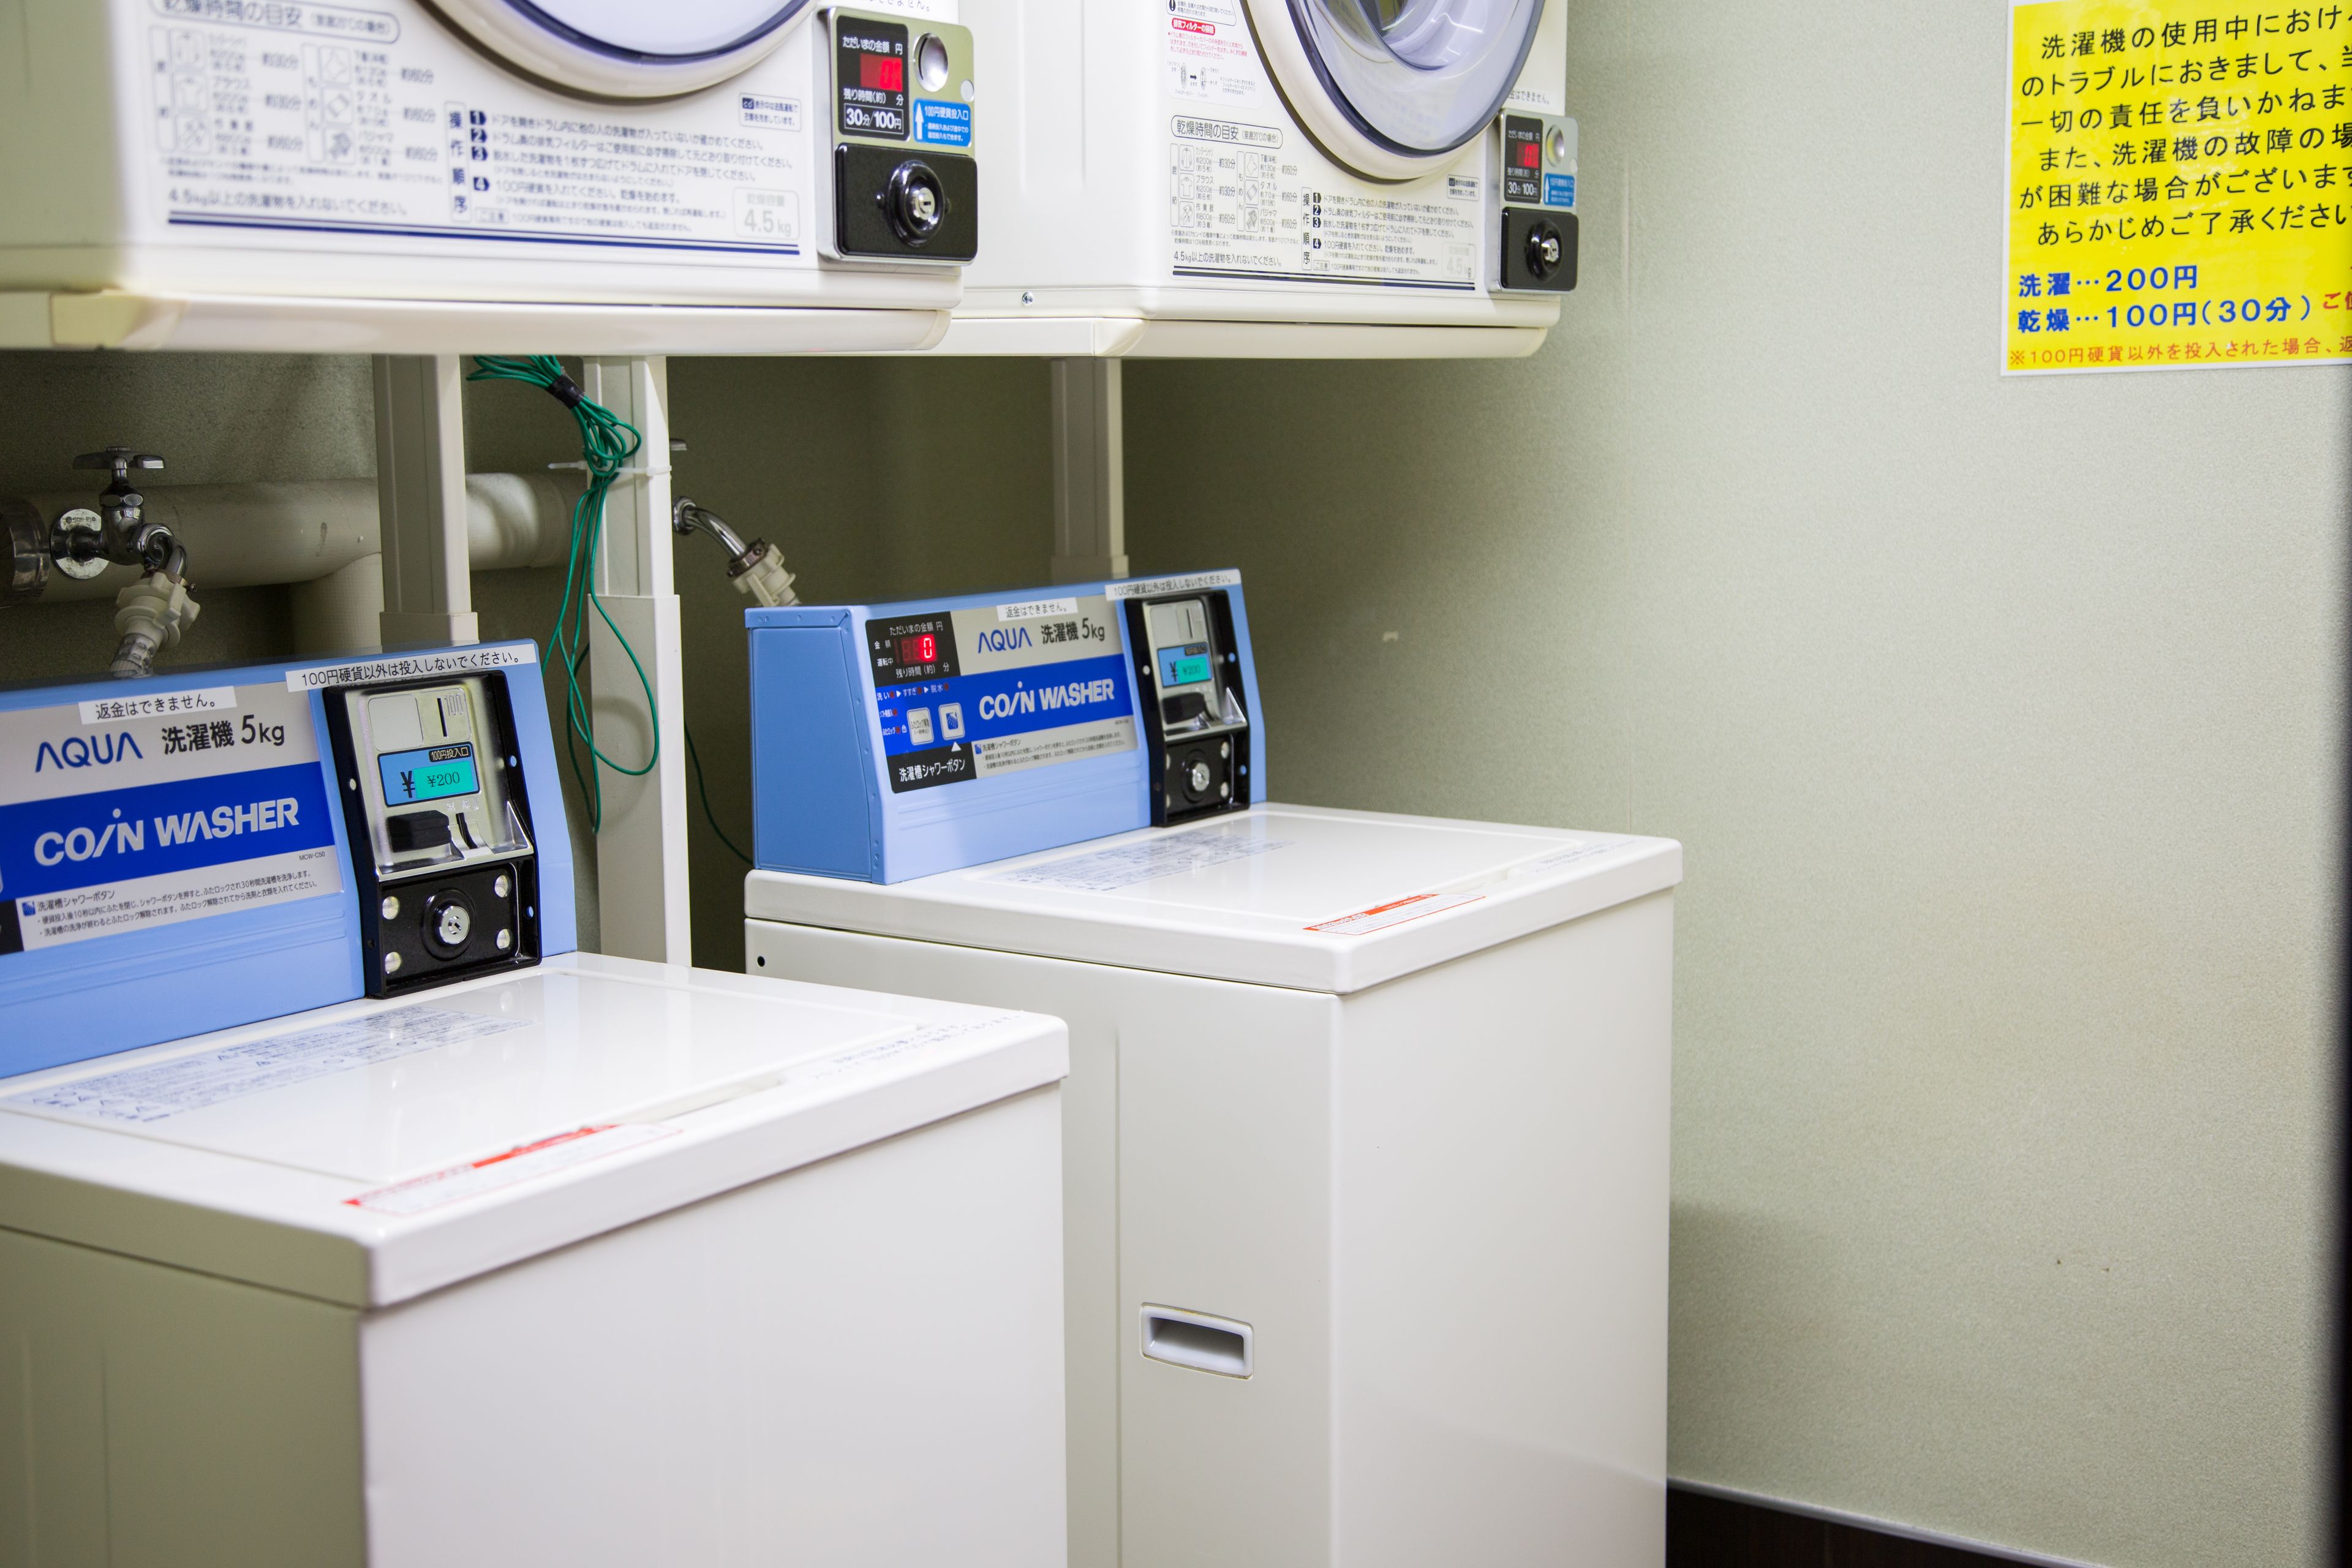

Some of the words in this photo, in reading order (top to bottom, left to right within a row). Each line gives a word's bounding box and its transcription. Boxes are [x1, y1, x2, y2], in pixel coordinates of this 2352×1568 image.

[2041, 5, 2352, 59] 洗濯機の使用中におけ
[842, 36, 890, 53] ただいまの金額
[895, 43, 903, 55] 円
[896, 94, 903, 106] 分
[2021, 83, 2352, 134] 一切の責任を負いかねま
[1176, 119, 1239, 141] 乾燥時間の目安
[2039, 122, 2352, 172] また、洗濯機の故障の場
[1005, 602, 1068, 619] 返金はできません。
[890, 621, 934, 636] ただいまの金額
[937, 621, 944, 631] 円
[1041, 620, 1079, 644] 洗濯機
[1082, 617, 1105, 641] 5kg
[923, 637, 933, 659] 0
[978, 627, 1033, 654] AQUA
[301, 651, 519, 687] 100円硬貨以外は投入しないでください。
[876, 658, 894, 666] 運転中
[943, 662, 950, 673] 分
[876, 692, 890, 701] 洗い
[902, 687, 917, 696] すすぎ
[930, 684, 943, 693] 脱水
[1039, 678, 1115, 711] WASHER
[95, 693, 216, 721] 返金はできません。
[161, 720, 235, 756] 洗濯機
[240, 714, 285, 746] 5kg
[35, 731, 143, 773] AQUA
[431, 747, 469, 761] 100円投入口
[427, 771, 461, 789] ¥200
[899, 758, 966, 782] 洗濯槽シャワーボタン
[154, 797, 300, 847] WASHER
[299, 851, 326, 861] MCW-C50
[37, 890, 115, 912] 洗濯槽シャワーボタン
